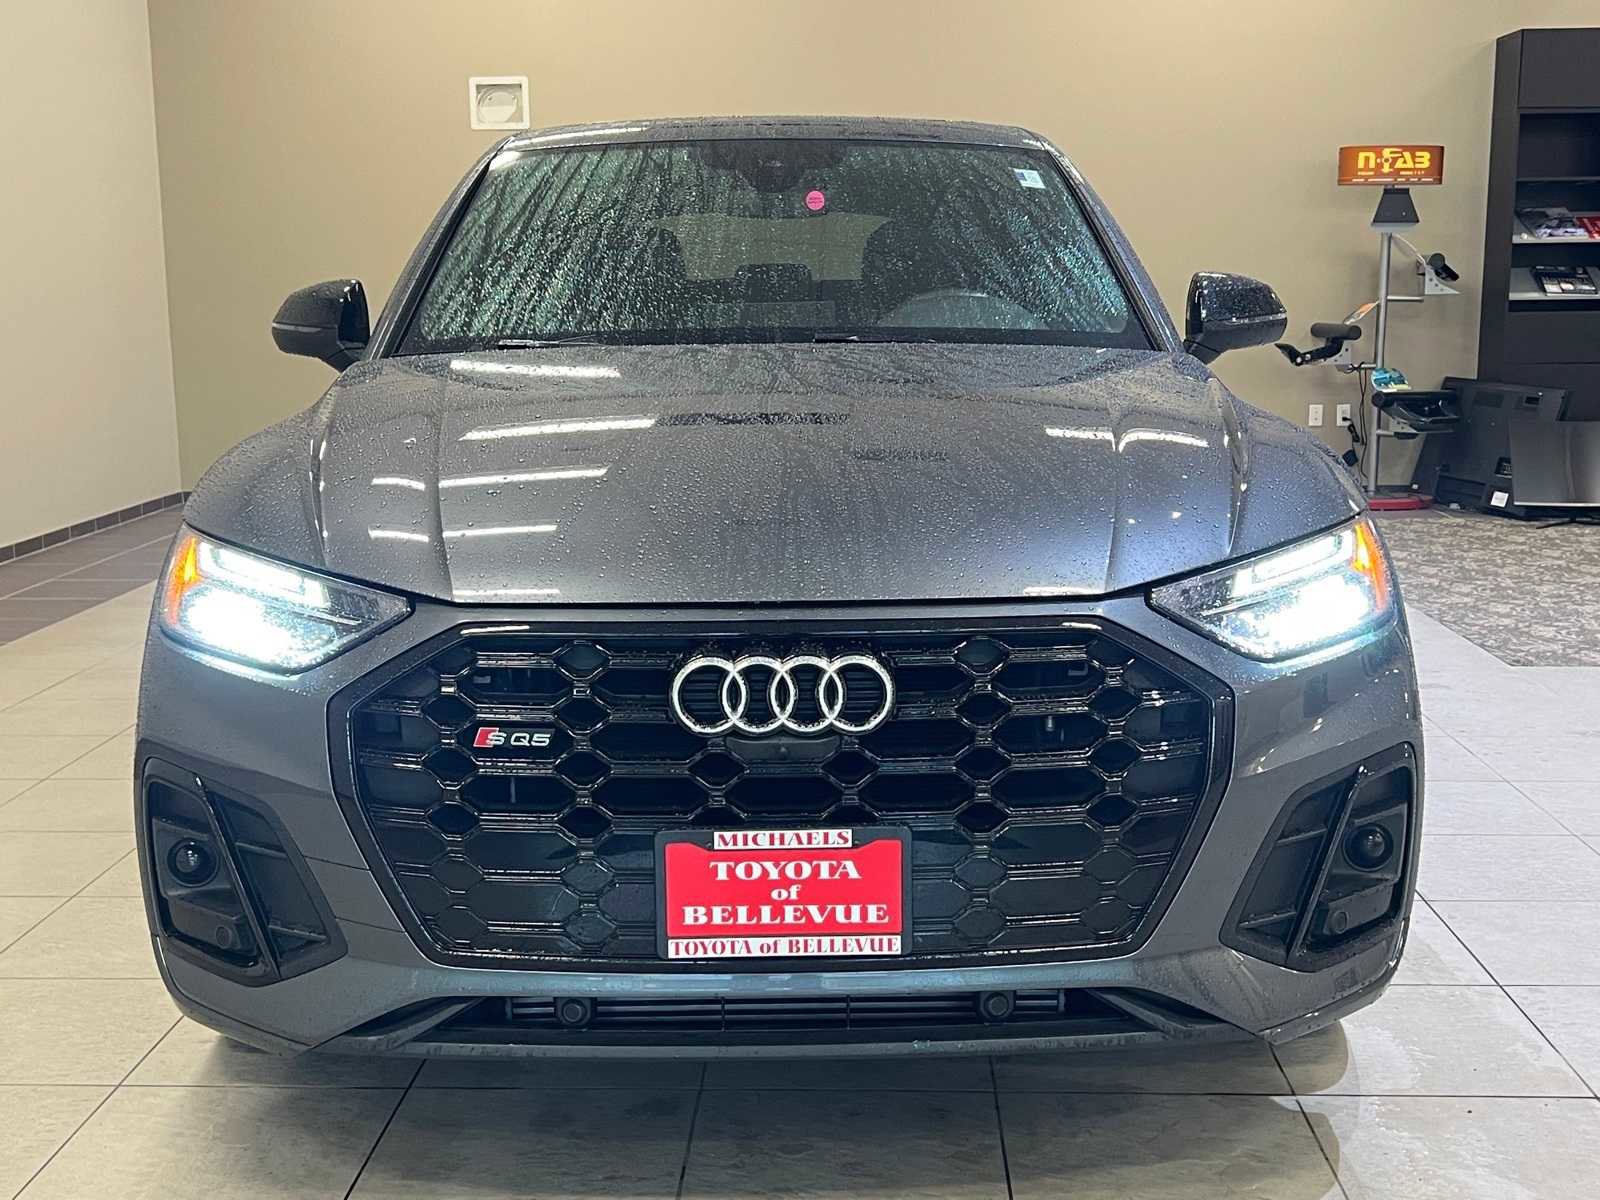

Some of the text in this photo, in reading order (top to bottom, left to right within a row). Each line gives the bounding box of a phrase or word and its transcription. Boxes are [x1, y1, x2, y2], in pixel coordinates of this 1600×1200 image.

[717, 831, 850, 847] MICHAELS
[709, 860, 862, 880] TOYOTA
[771, 884, 802, 901] of
[682, 904, 889, 925] BELLEVUE
[670, 937, 900, 956] TOYOTA of BELLEVUE
